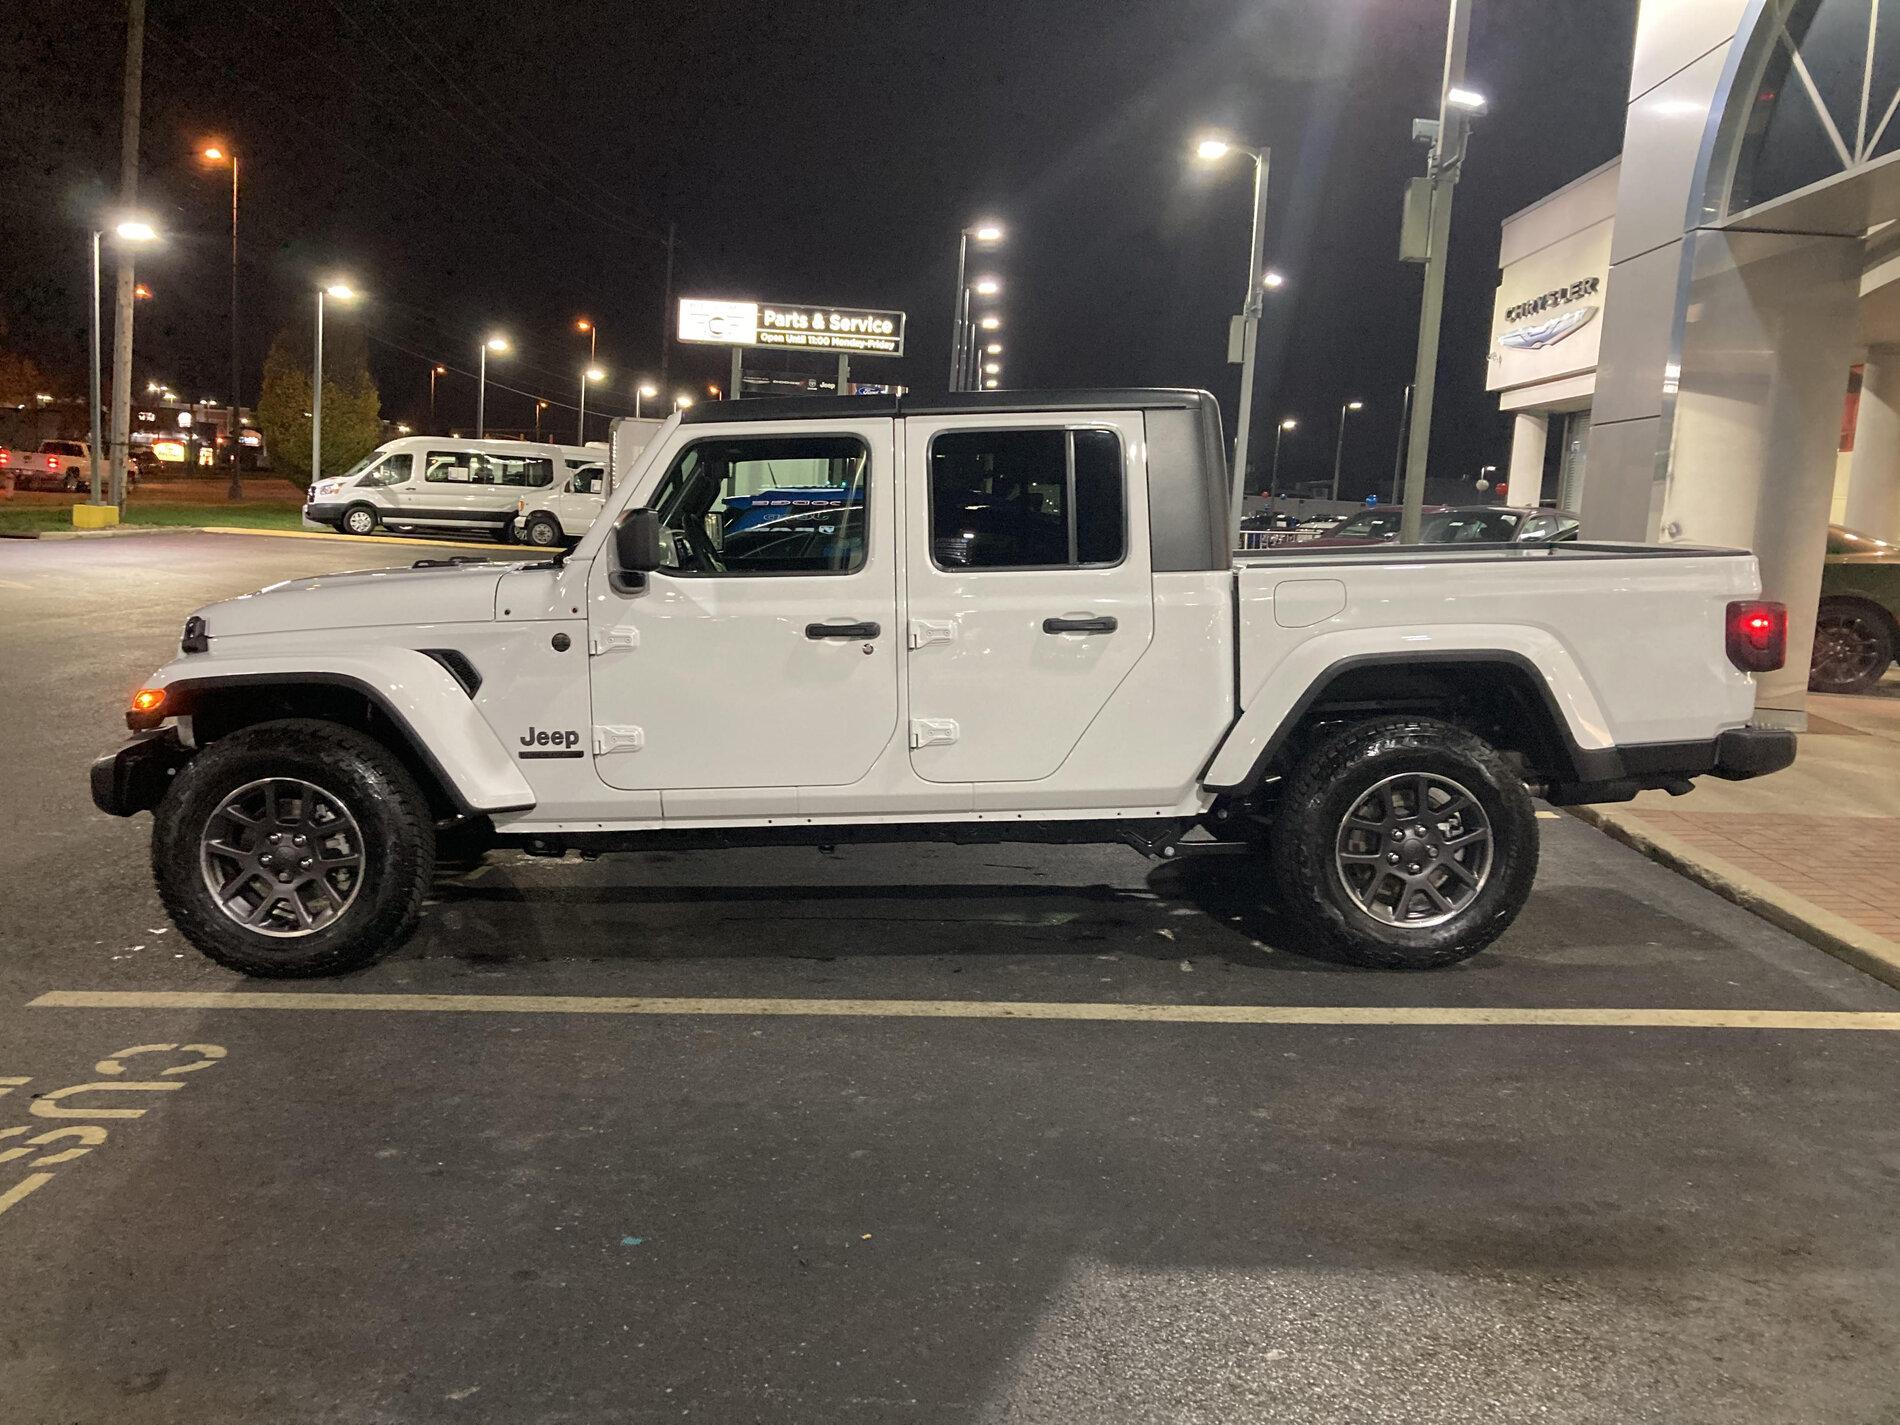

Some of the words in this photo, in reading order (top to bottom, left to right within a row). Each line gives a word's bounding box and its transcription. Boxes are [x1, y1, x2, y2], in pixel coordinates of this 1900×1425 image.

[1505, 277, 1600, 322] CHRYSLER
[764, 309, 808, 328] Parts
[812, 312, 825, 329] &
[829, 314, 893, 334] Service
[760, 332, 785, 343] Open
[785, 334, 807, 344] Until
[819, 381, 836, 390] Jeep
[519, 726, 580, 749] Jeep
